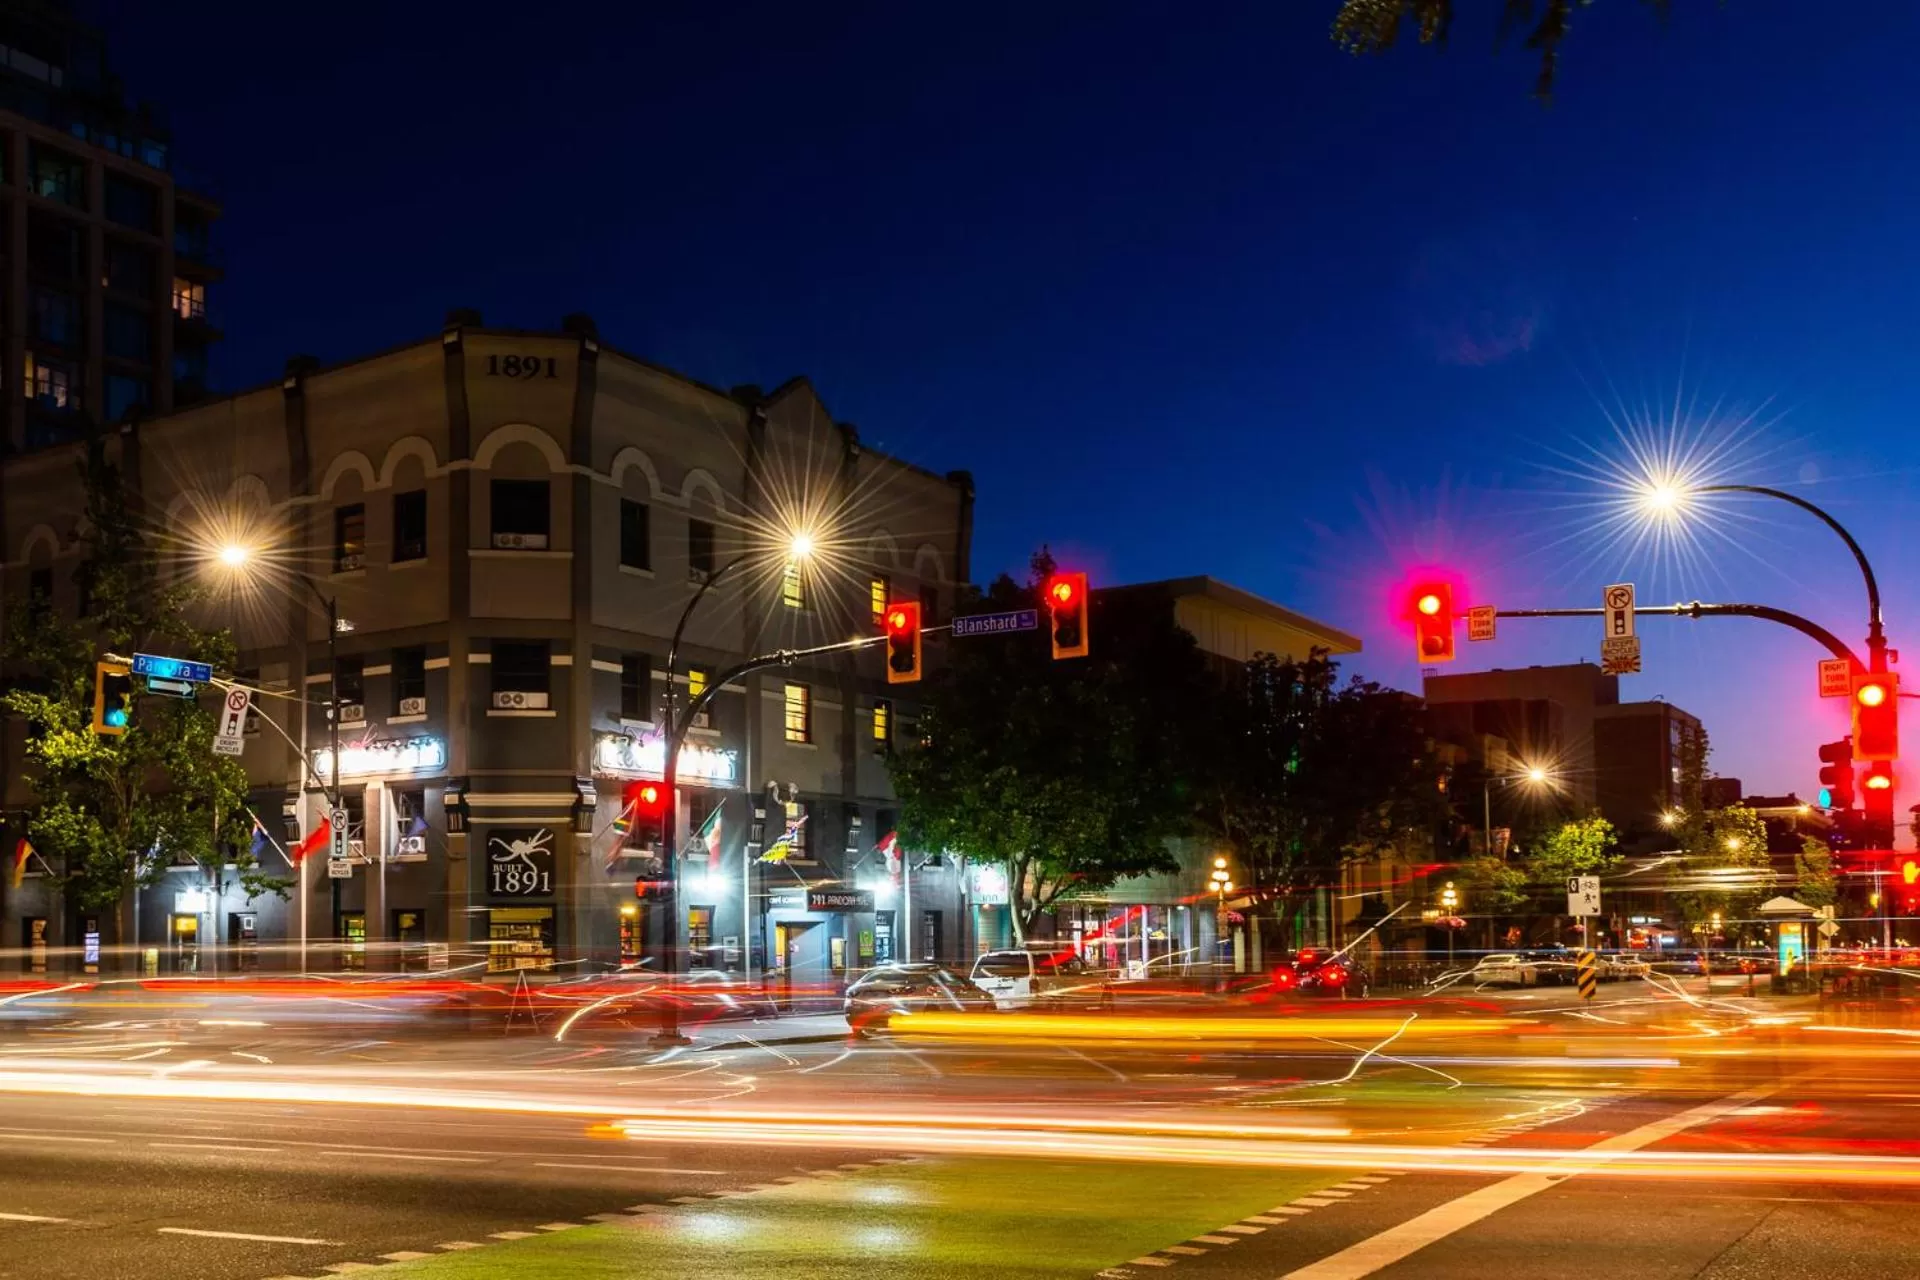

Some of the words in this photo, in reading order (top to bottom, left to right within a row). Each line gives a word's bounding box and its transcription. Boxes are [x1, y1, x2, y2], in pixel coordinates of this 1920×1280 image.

[487, 354, 559, 380] 1891
[956, 614, 1018, 634] Blanshard
[138, 658, 191, 678] Panora
[493, 863, 524, 873] BUILT
[493, 871, 551, 895] 1891
